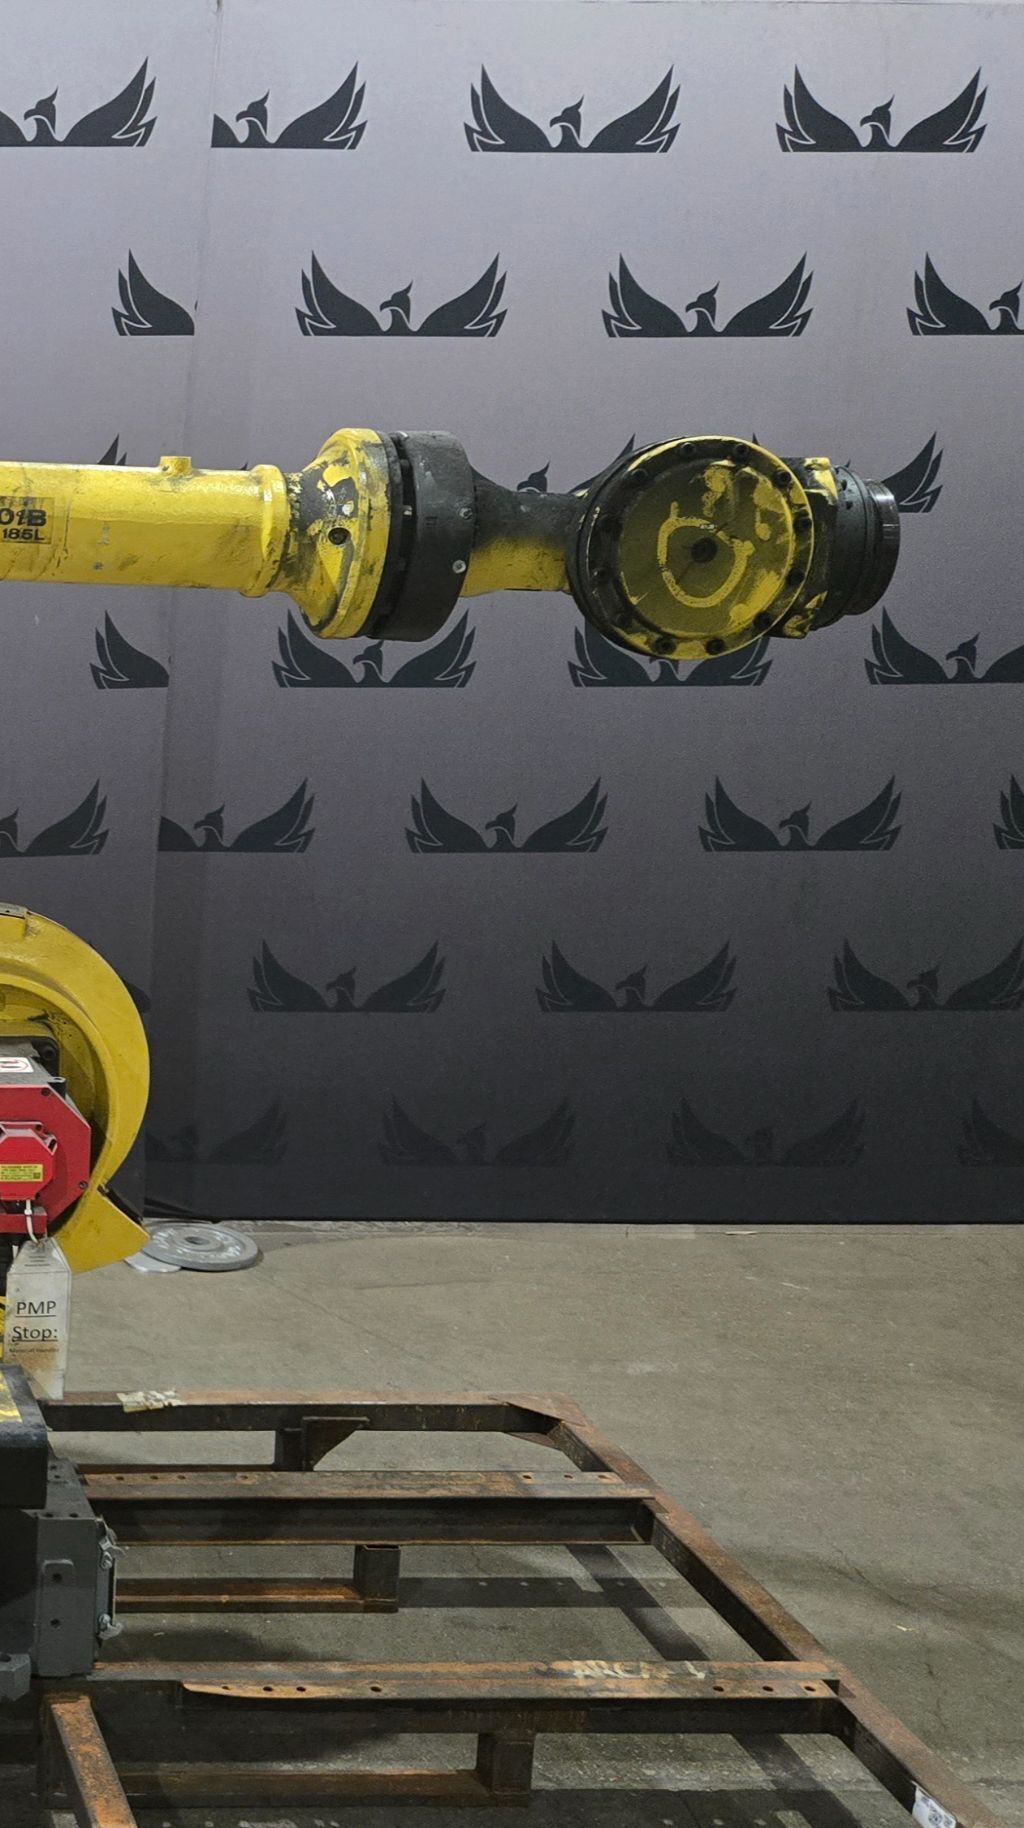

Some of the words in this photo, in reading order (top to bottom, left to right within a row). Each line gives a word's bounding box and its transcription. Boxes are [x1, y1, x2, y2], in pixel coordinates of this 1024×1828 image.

[2, 528, 45, 541] 185L
[16, 1300, 57, 1315] PMP
[12, 1325, 58, 1342] Stop:
